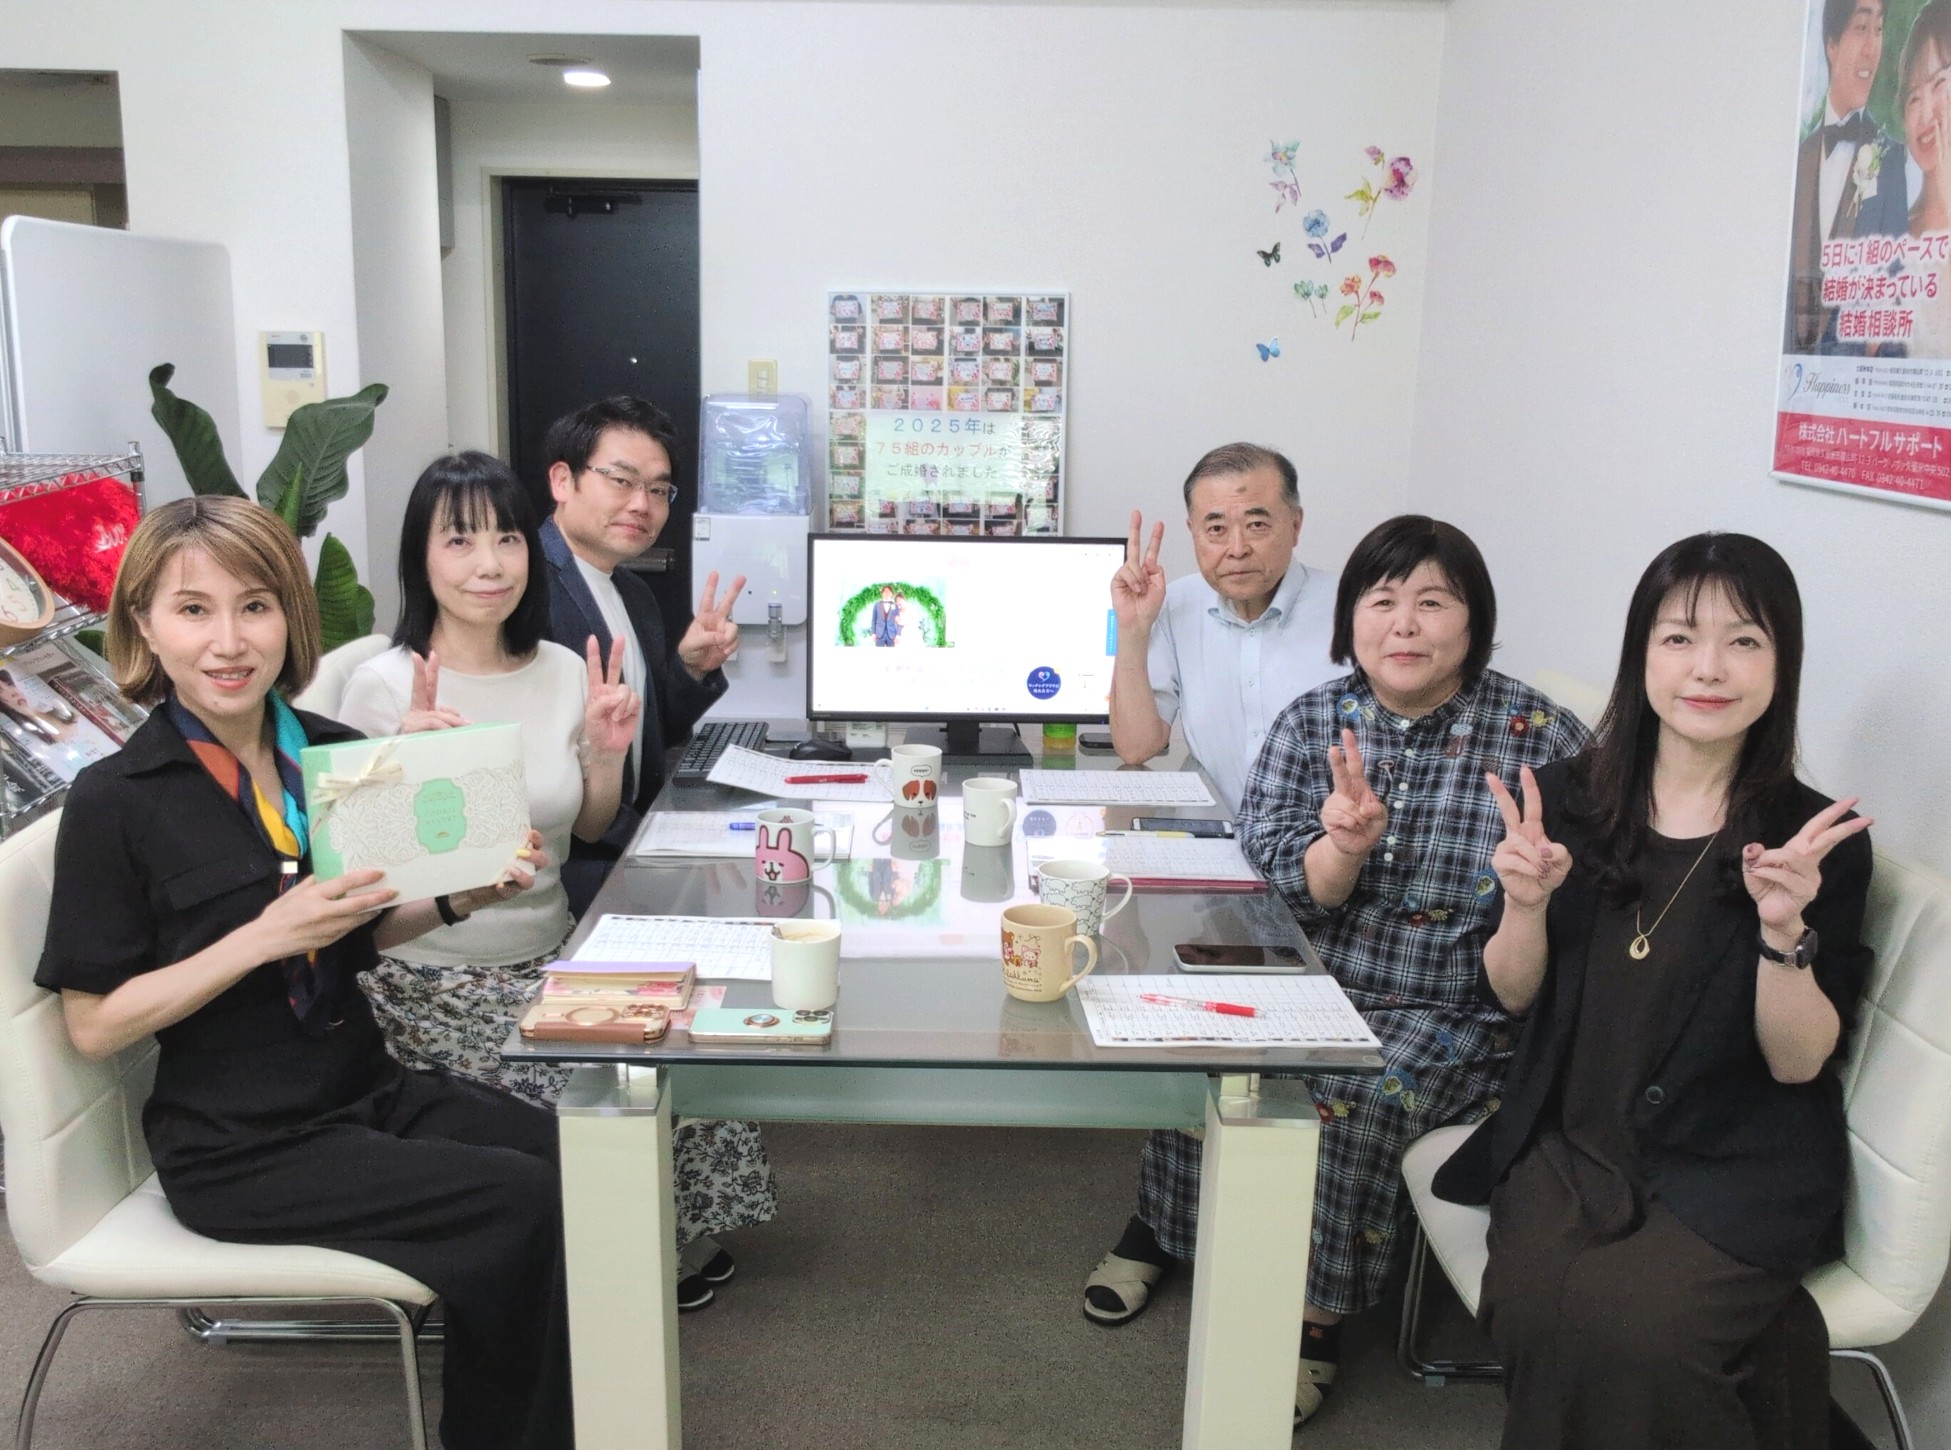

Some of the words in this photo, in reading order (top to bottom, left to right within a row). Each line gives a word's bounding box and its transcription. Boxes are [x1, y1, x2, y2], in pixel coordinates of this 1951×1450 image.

[1822, 235, 1949, 268] 5日に1組のペースで
[1822, 273, 1938, 302] 結婚が決まっている
[1839, 309, 1914, 338] 結婚相談所
[1803, 372, 1851, 400] Happiness
[887, 464, 999, 479] ご成婚されました
